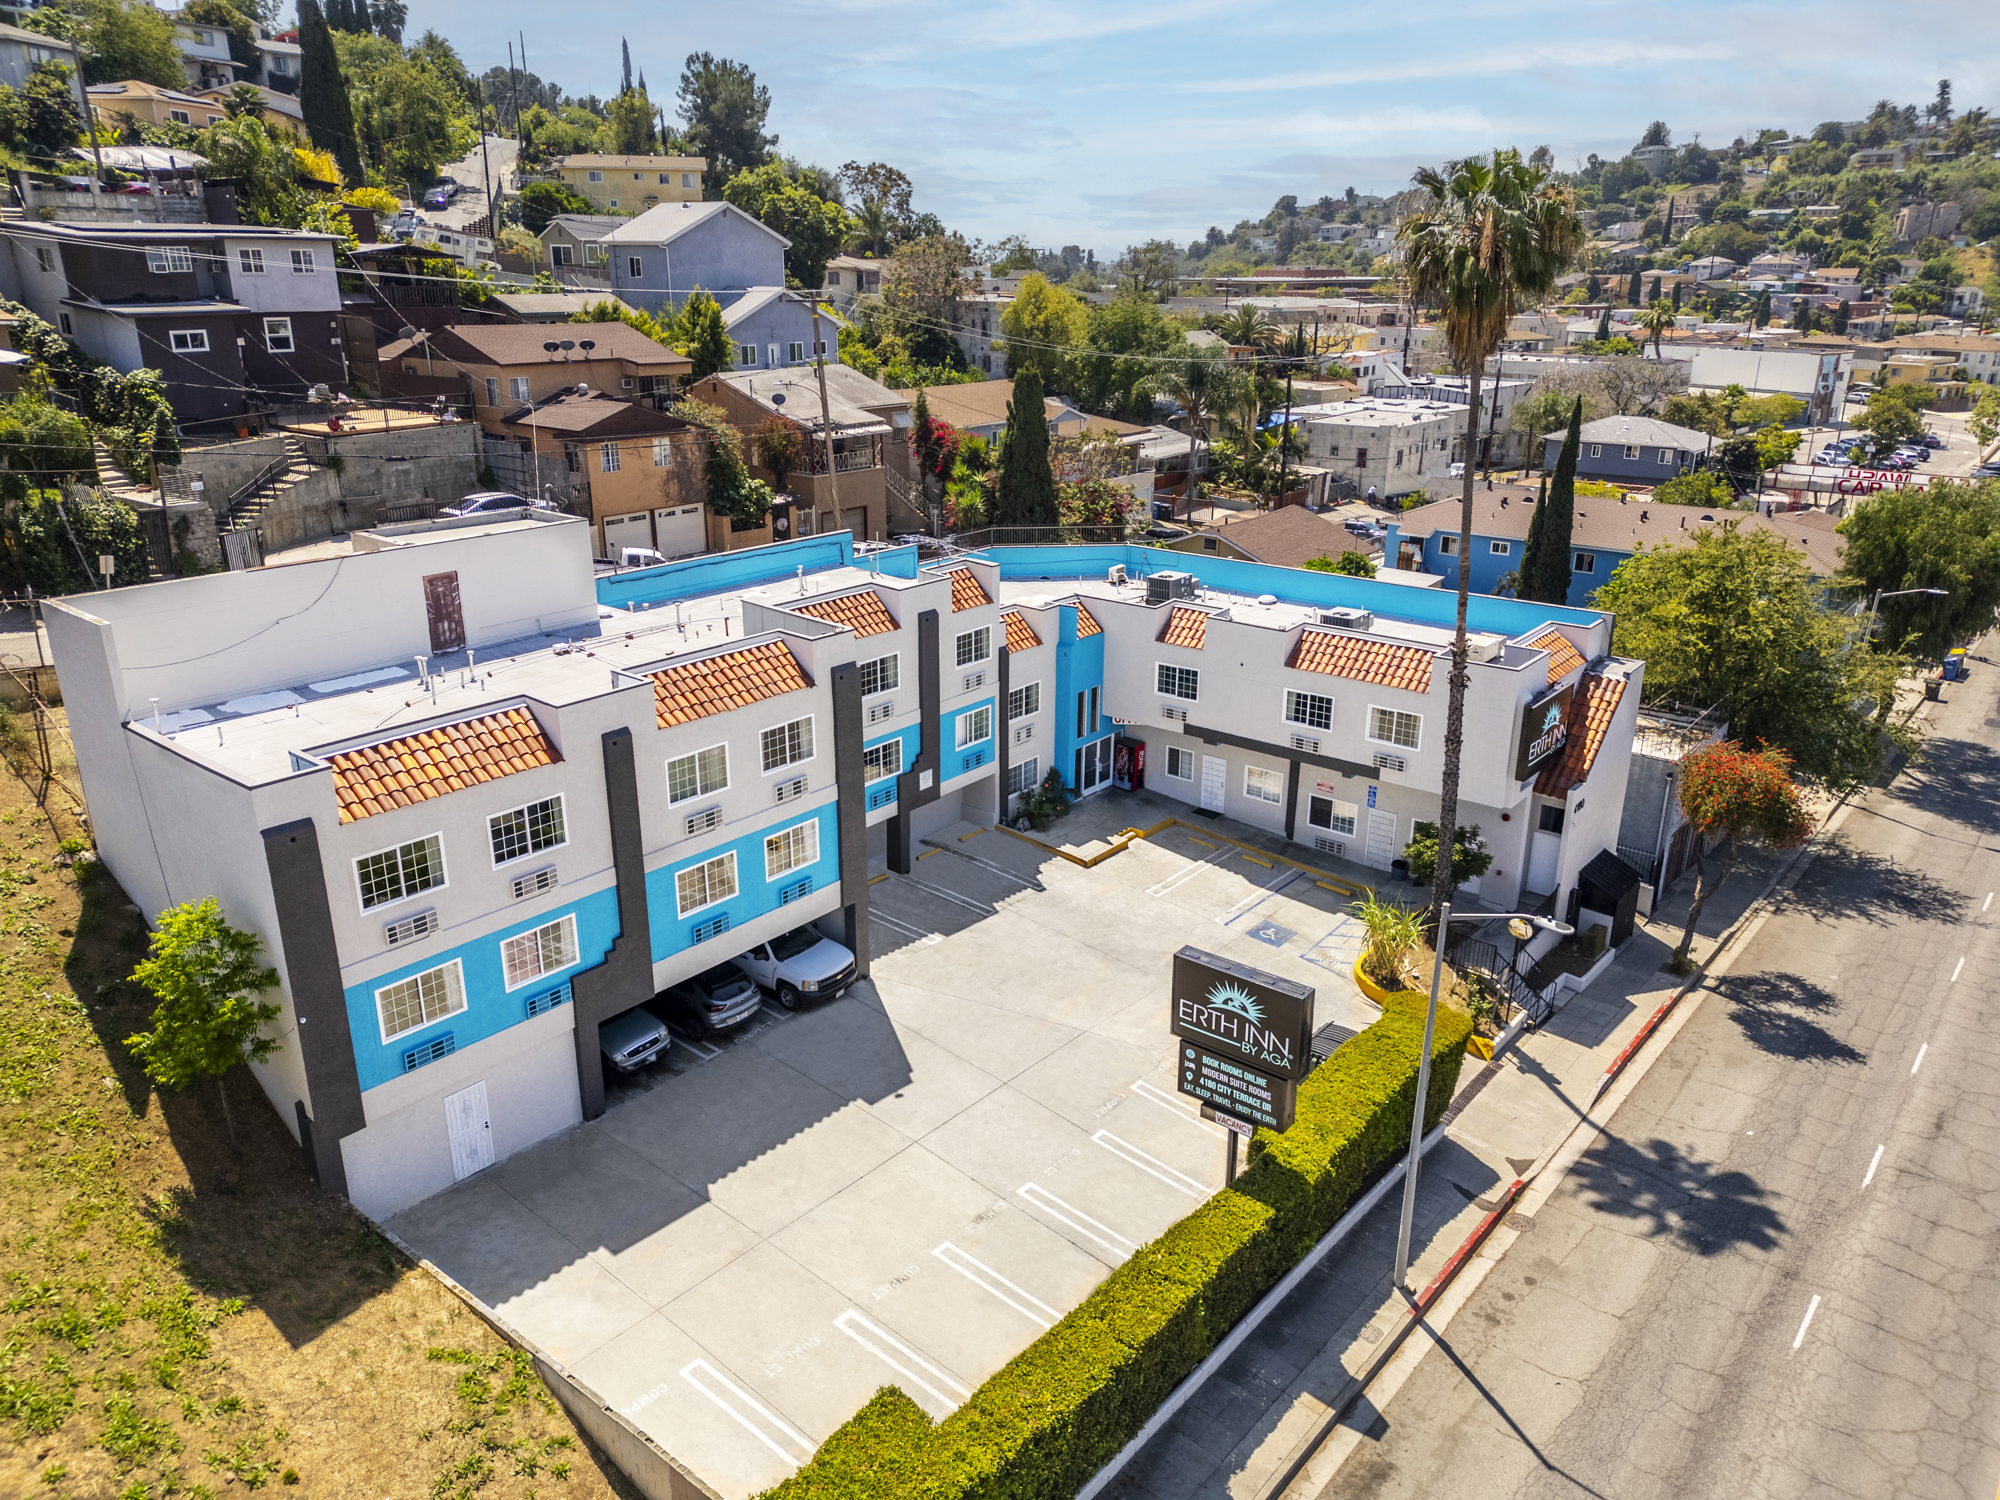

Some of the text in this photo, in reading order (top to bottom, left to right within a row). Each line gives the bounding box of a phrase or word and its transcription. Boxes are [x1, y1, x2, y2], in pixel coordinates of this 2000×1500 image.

[1837, 479, 1883, 494] CAR
[1528, 731, 1552, 760] ERTH
[1328, 950, 1345, 960] NO
[733, 1021, 773, 1044] COMPACT
[1179, 998, 1290, 1058] ERTH INN
[1241, 1041, 1291, 1070] BY AGA
[1202, 1055, 1267, 1088] BOOK ROOMS ONLINE
[1202, 1066, 1272, 1101] MODERN SUITE ROOMS
[1092, 1093, 1126, 1118] COMPACT
[1199, 1077, 1272, 1113] 4180 CITY TERRACE DR
[1212, 1093, 1232, 1108] TRAVEL
[1235, 1103, 1252, 1116] ENJOY
[1252, 1109, 1263, 1120] THE
[1262, 1114, 1277, 1127] ERTH
[1216, 1111, 1252, 1135] VACANCY
[1043, 1148, 1081, 1177] COMPACT
[871, 1264, 920, 1301] COMPACT
[620, 1383, 668, 1415] COMPA
